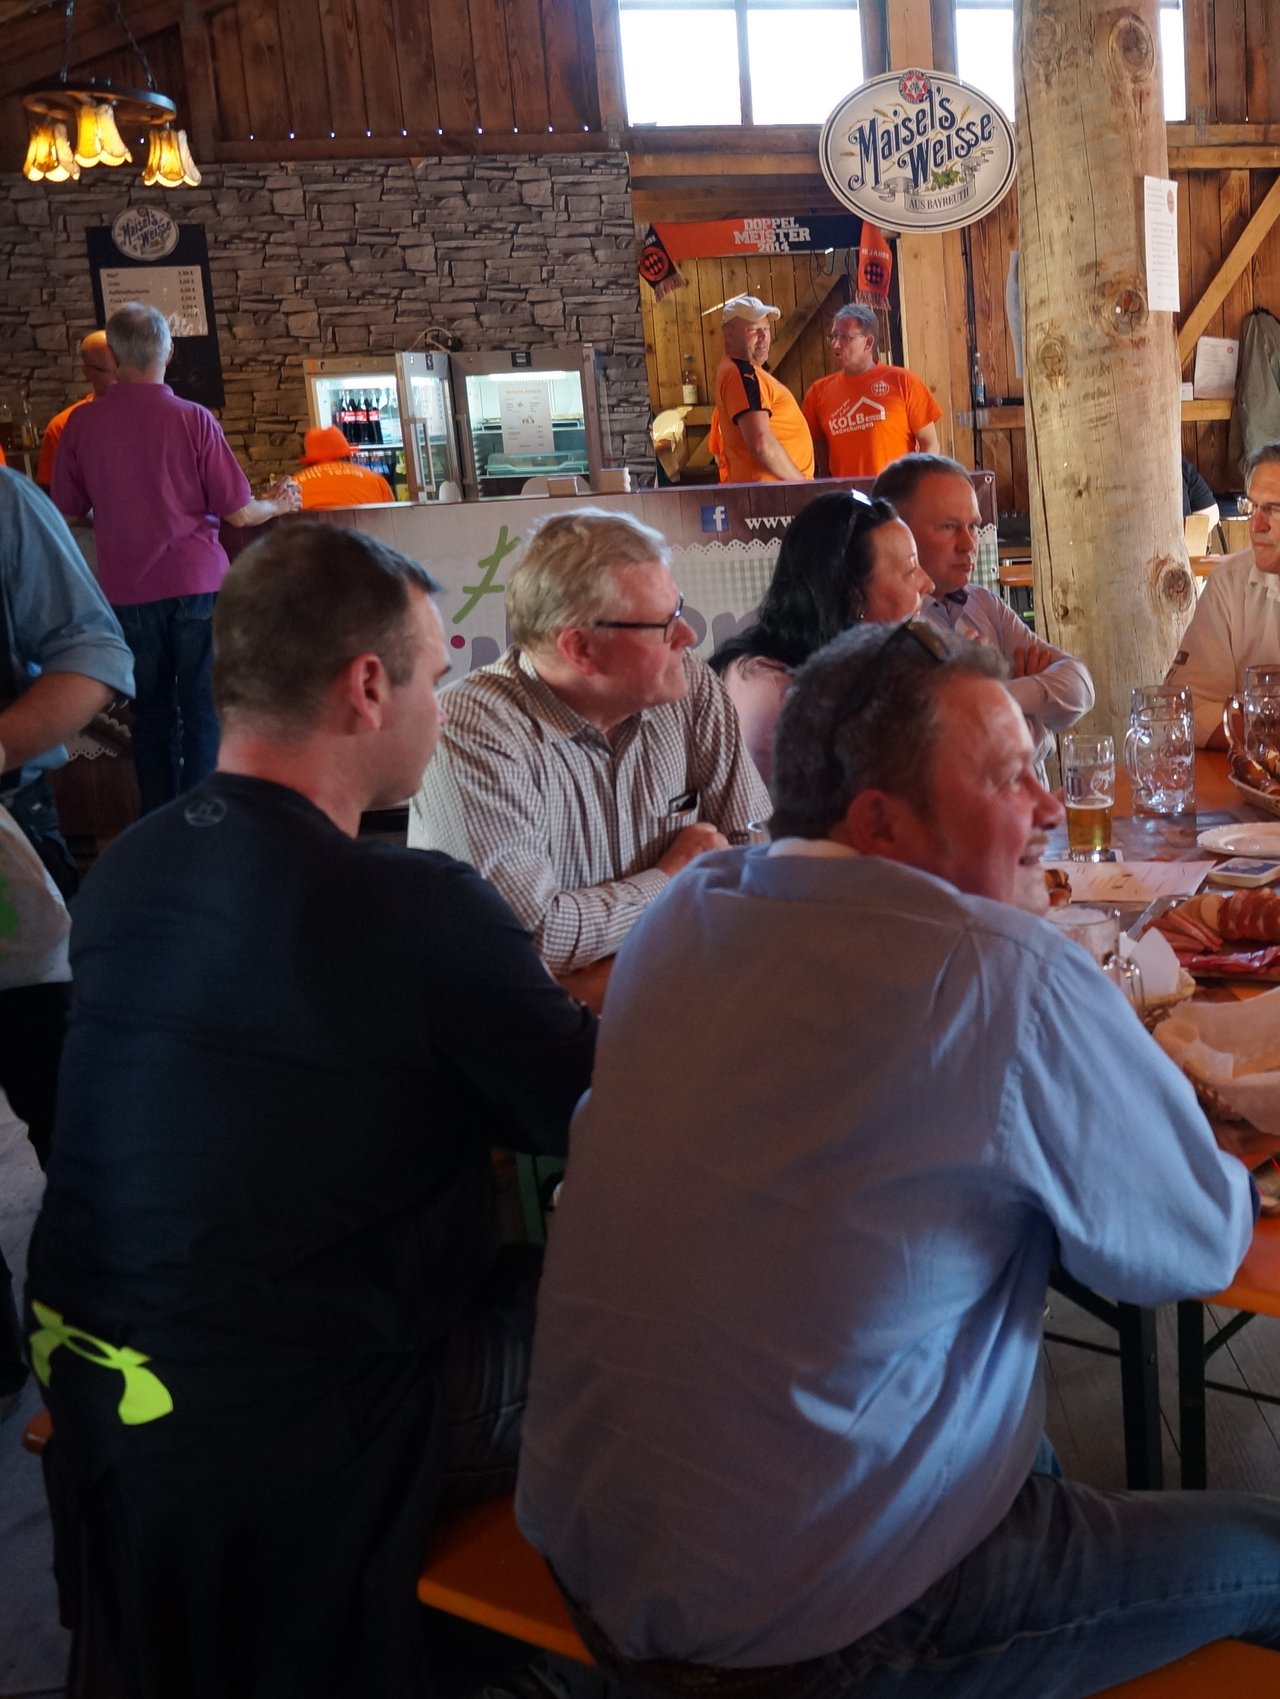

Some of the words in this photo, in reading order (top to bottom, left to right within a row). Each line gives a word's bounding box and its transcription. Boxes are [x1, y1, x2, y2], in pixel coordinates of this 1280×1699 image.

[848, 86, 956, 191] Maisel's
[897, 113, 997, 190] Weisse
[909, 198, 926, 210] AUS
[927, 189, 970, 209] BAYREUTH
[743, 217, 800, 231] DOPPEL
[734, 227, 811, 245] MEISTER
[757, 241, 790, 252] 2014
[828, 413, 865, 431] KOLB
